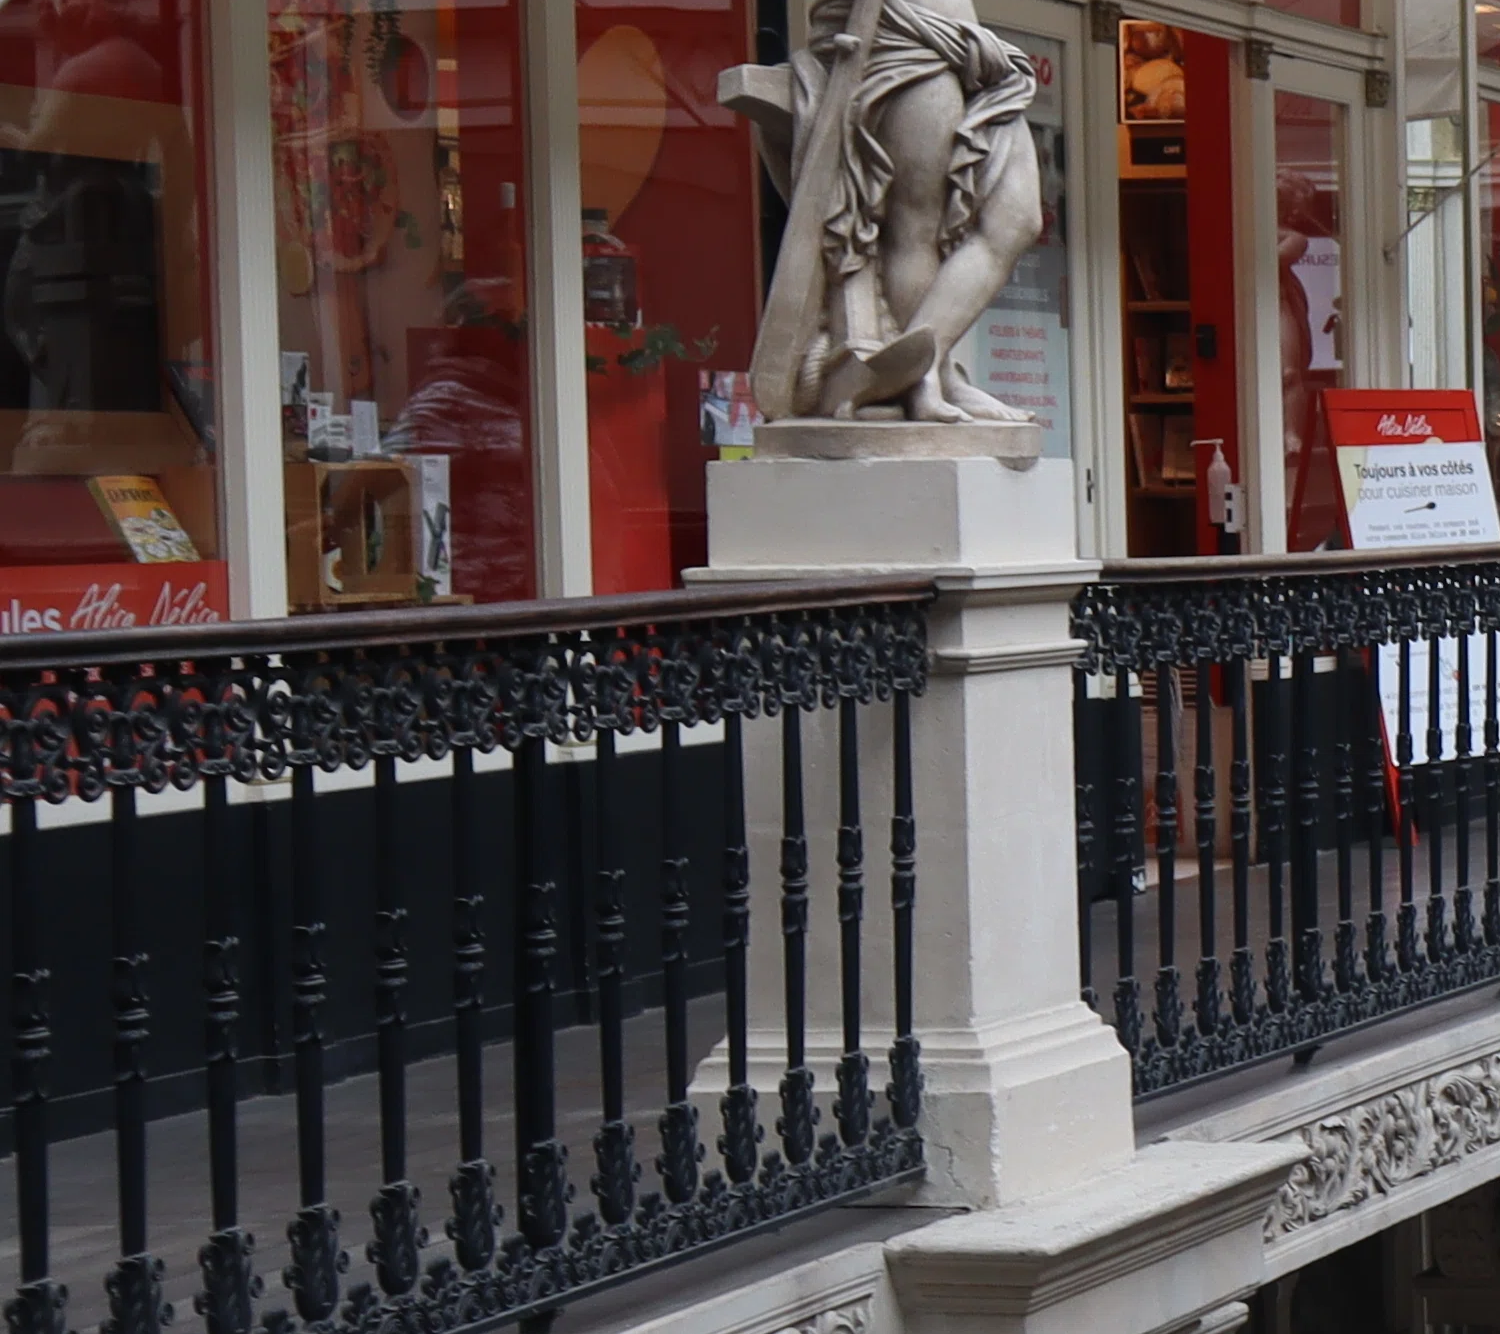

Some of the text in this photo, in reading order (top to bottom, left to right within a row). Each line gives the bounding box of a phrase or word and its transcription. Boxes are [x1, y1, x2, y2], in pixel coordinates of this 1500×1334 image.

[1354, 460, 1474, 482] Toujours à vos côtés
[1358, 481, 1478, 502] pour cuisiner maison
